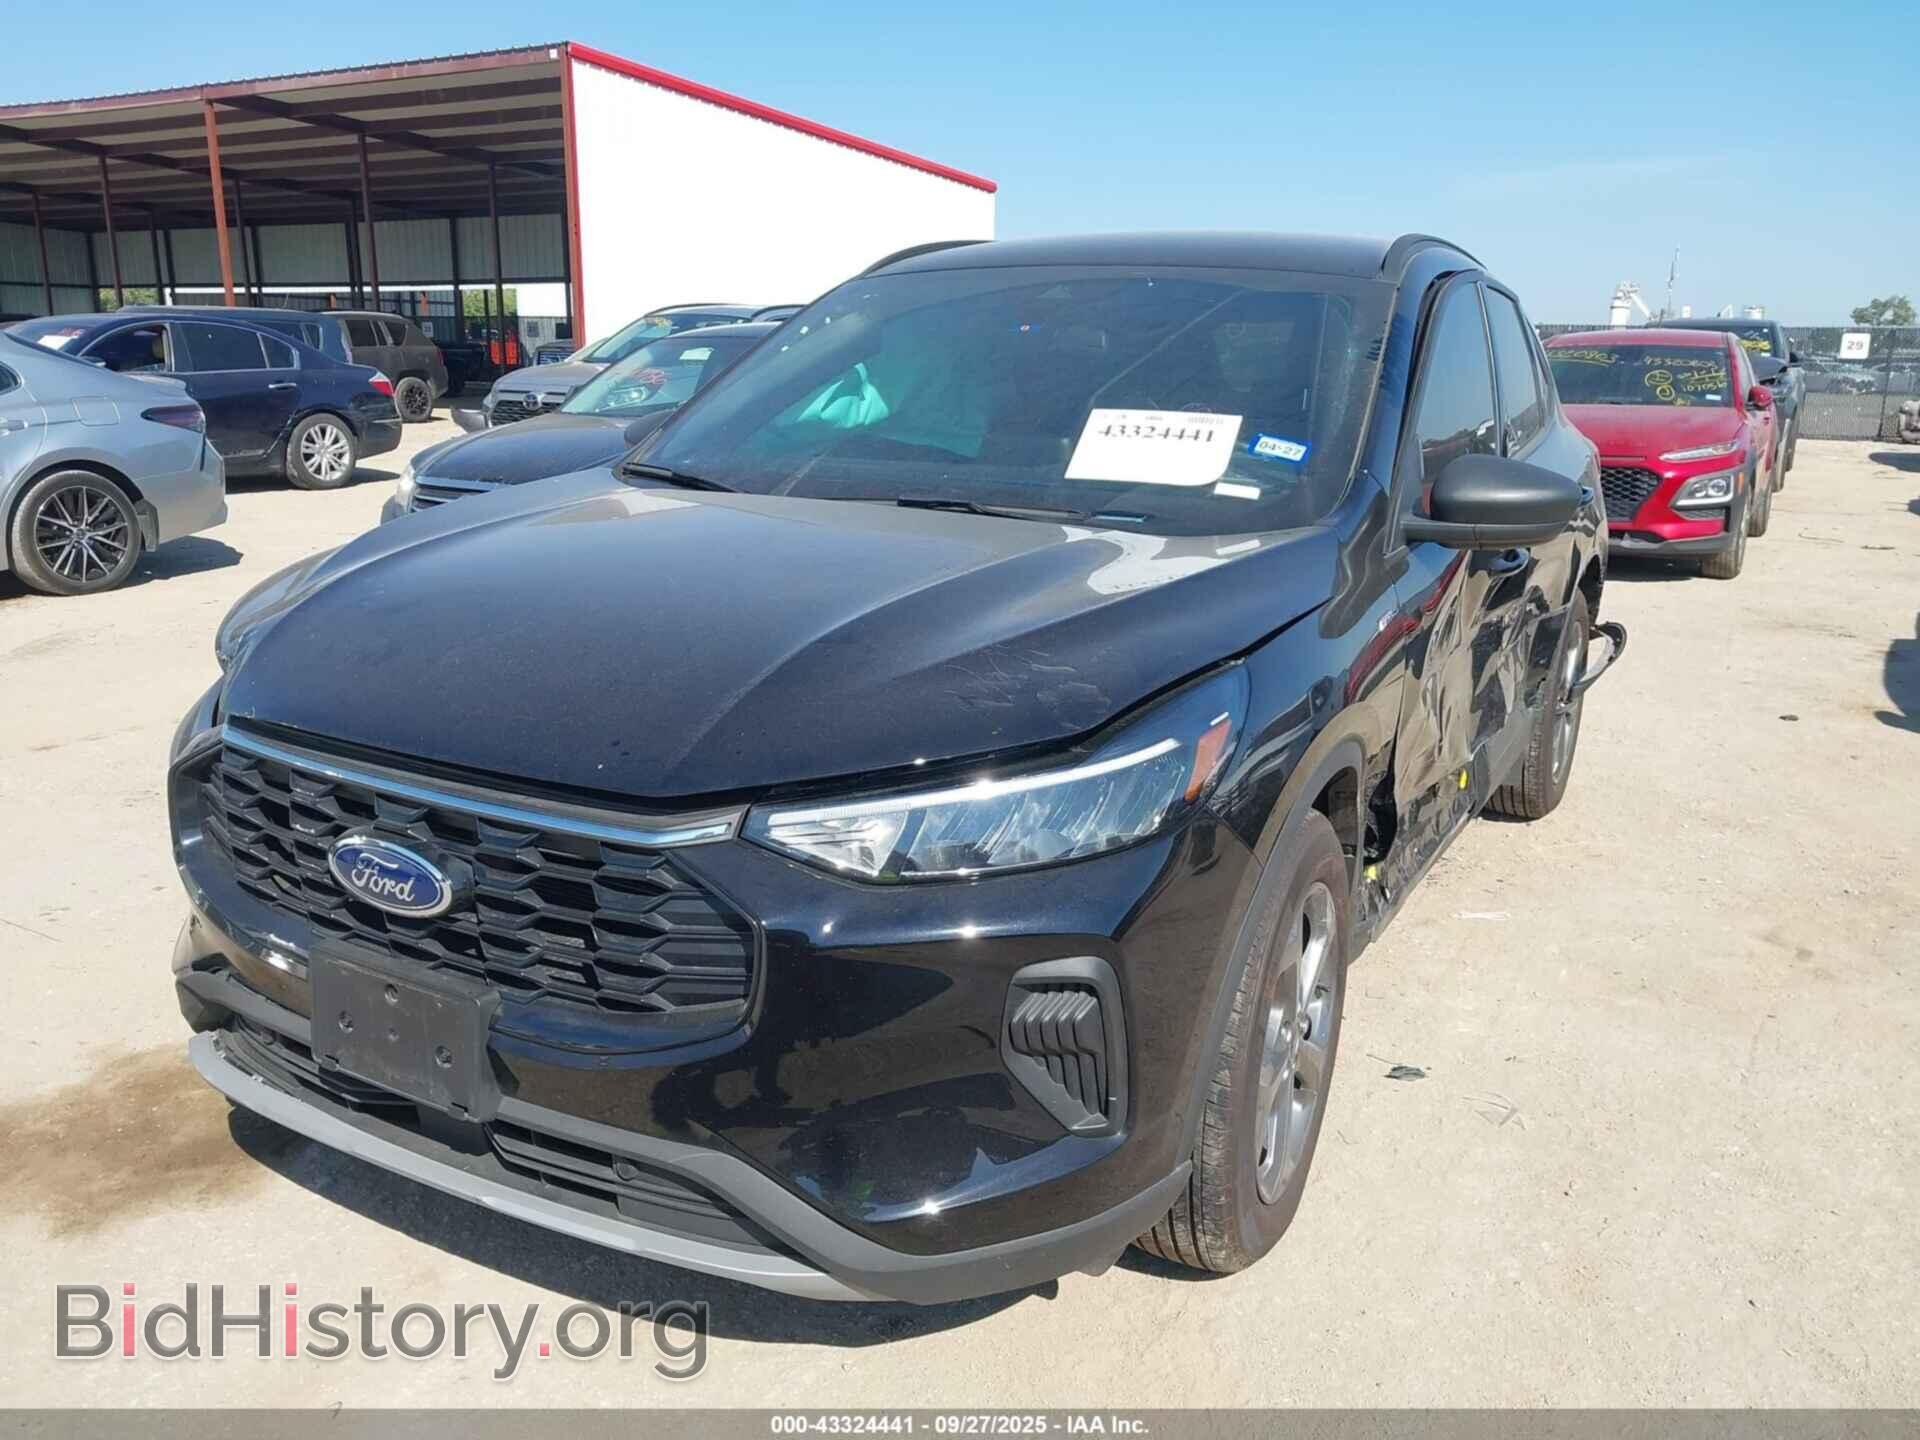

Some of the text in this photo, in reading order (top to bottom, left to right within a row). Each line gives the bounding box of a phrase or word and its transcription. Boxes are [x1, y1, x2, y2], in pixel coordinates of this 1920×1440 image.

[1847, 340, 1864, 350] 29
[1098, 424, 1215, 442] 43324441
[351, 852, 415, 902] Ford
